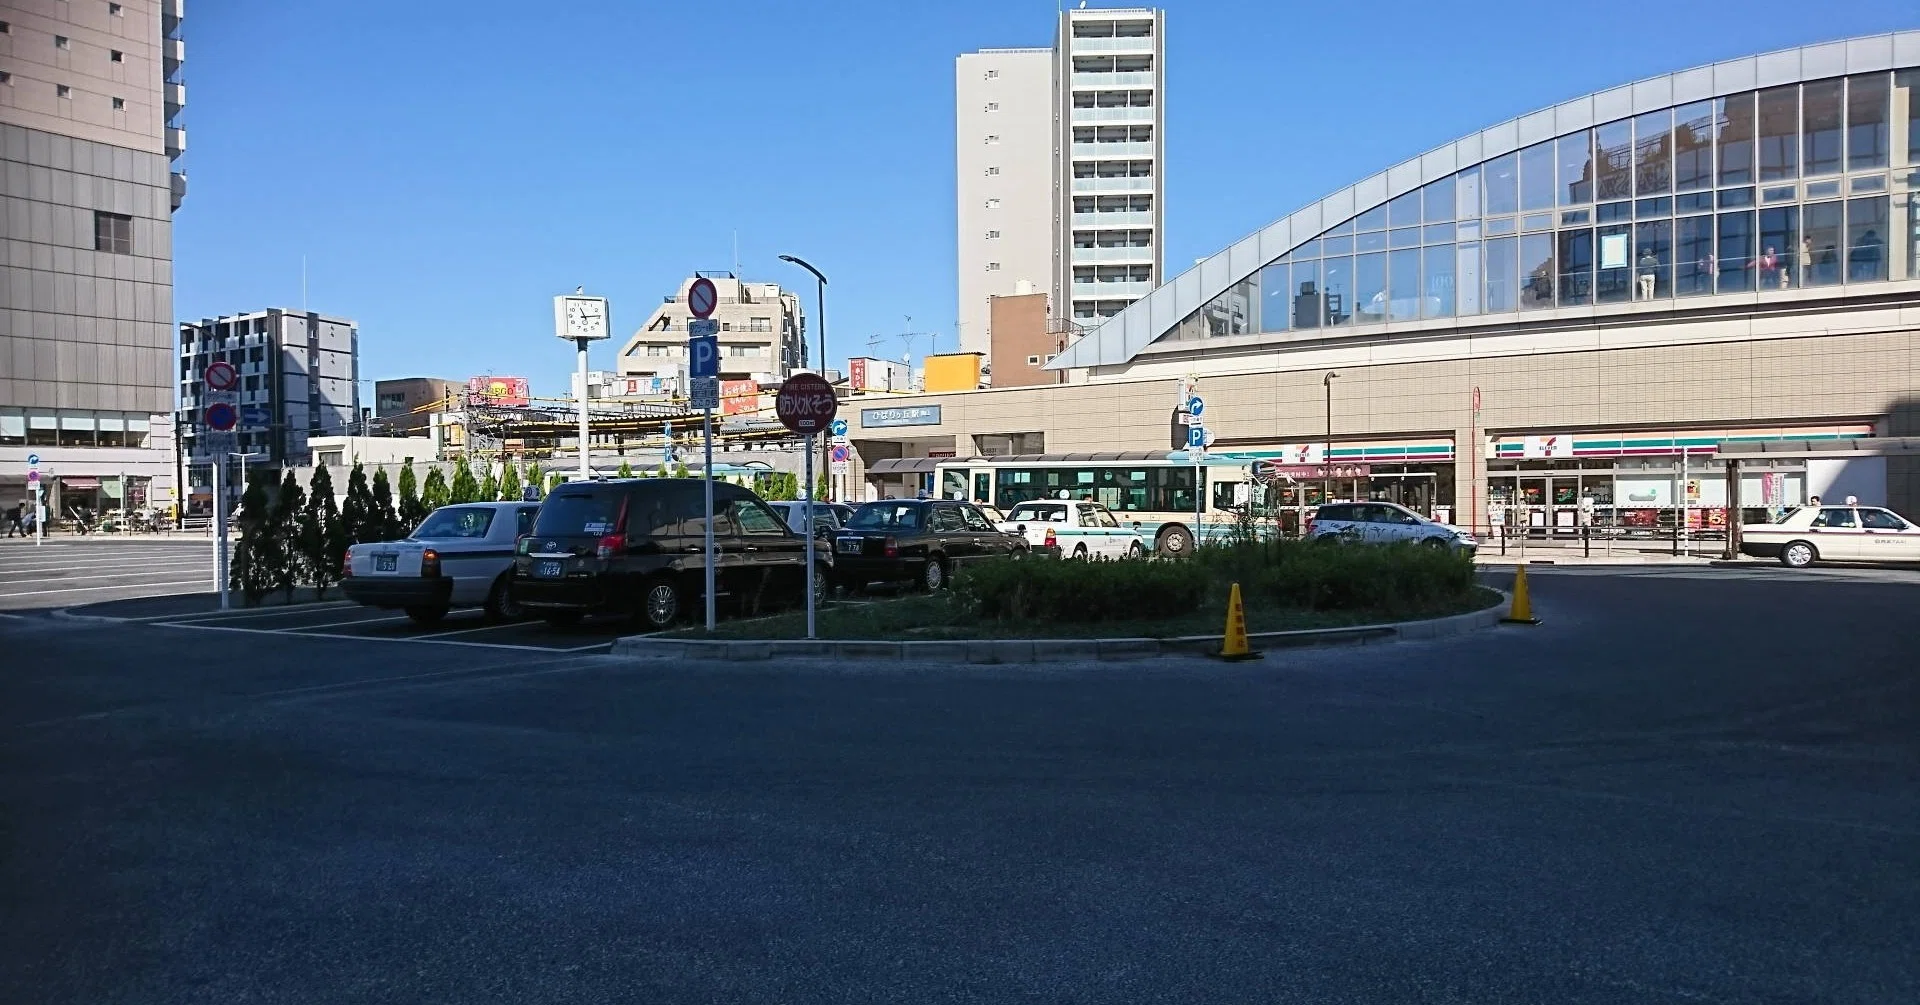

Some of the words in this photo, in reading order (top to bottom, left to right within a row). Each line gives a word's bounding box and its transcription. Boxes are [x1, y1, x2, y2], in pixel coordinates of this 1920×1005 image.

[696, 341, 713, 373] P
[779, 393, 834, 416] 防火水そう
[1192, 429, 1201, 445] P
